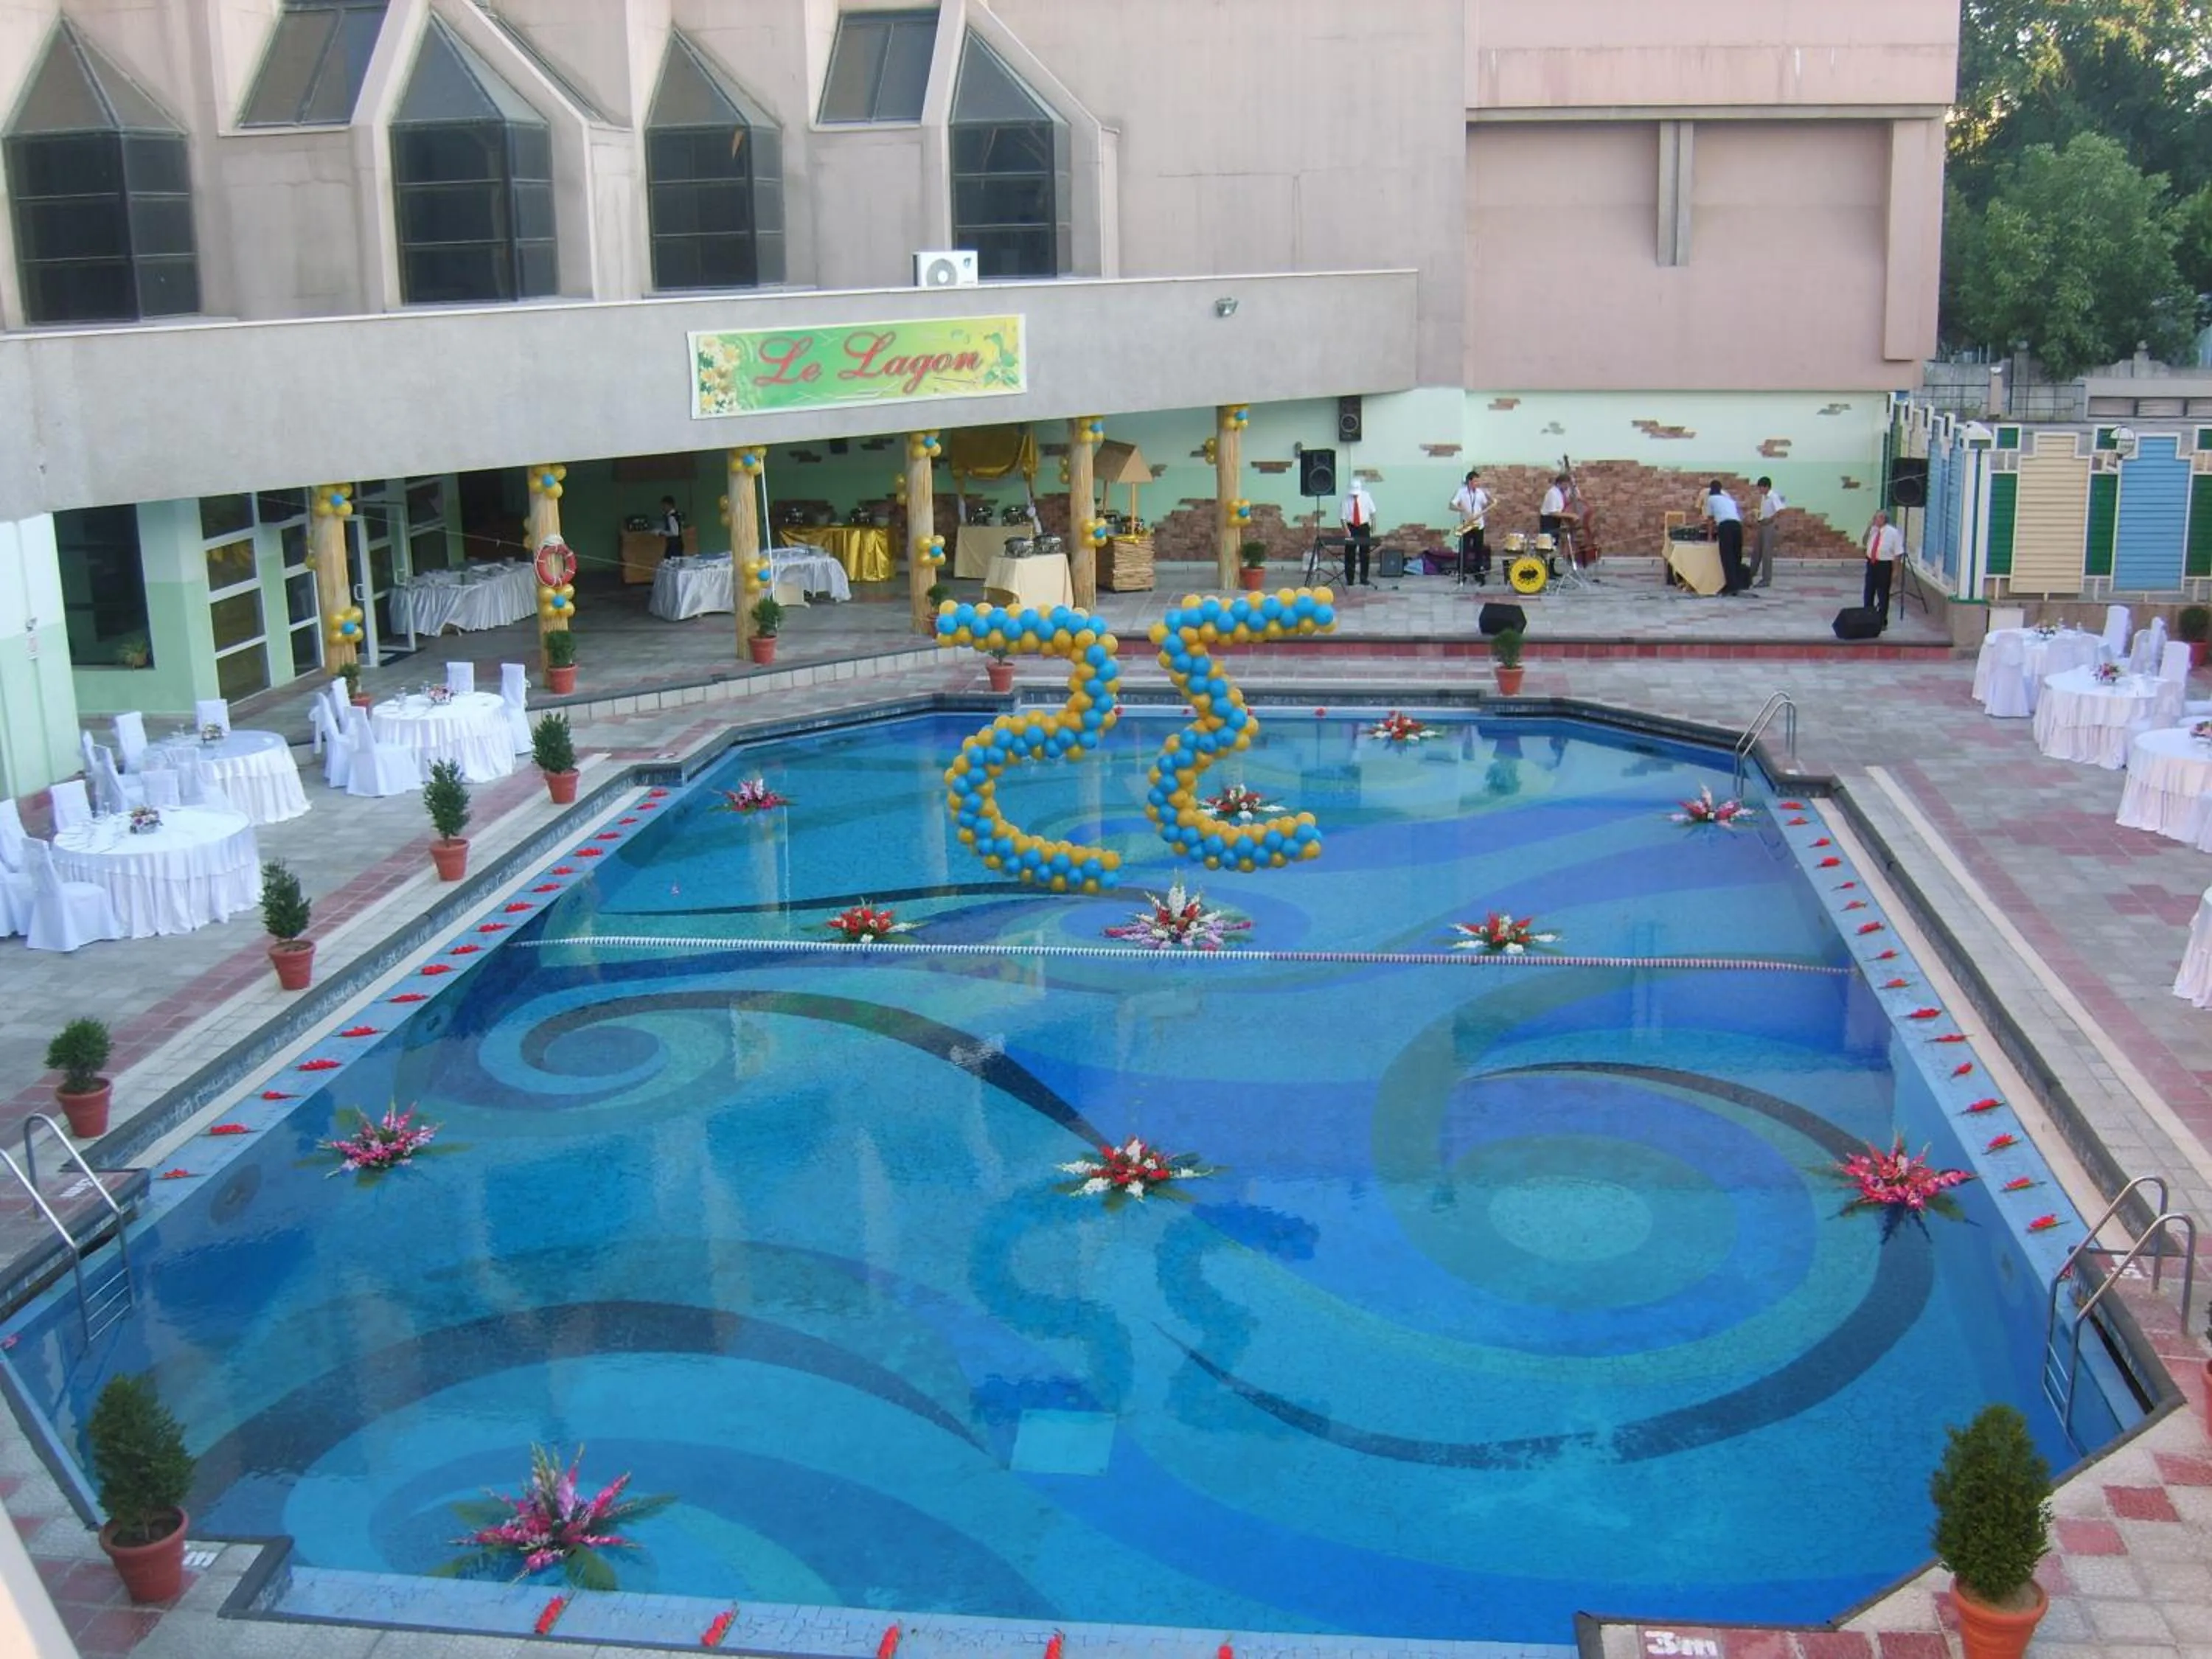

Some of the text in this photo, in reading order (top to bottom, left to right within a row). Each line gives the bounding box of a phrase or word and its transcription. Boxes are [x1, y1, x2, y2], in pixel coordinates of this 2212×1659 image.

[754, 331, 983, 394] Le Lagon
[1644, 1630, 1719, 1656] 3m
